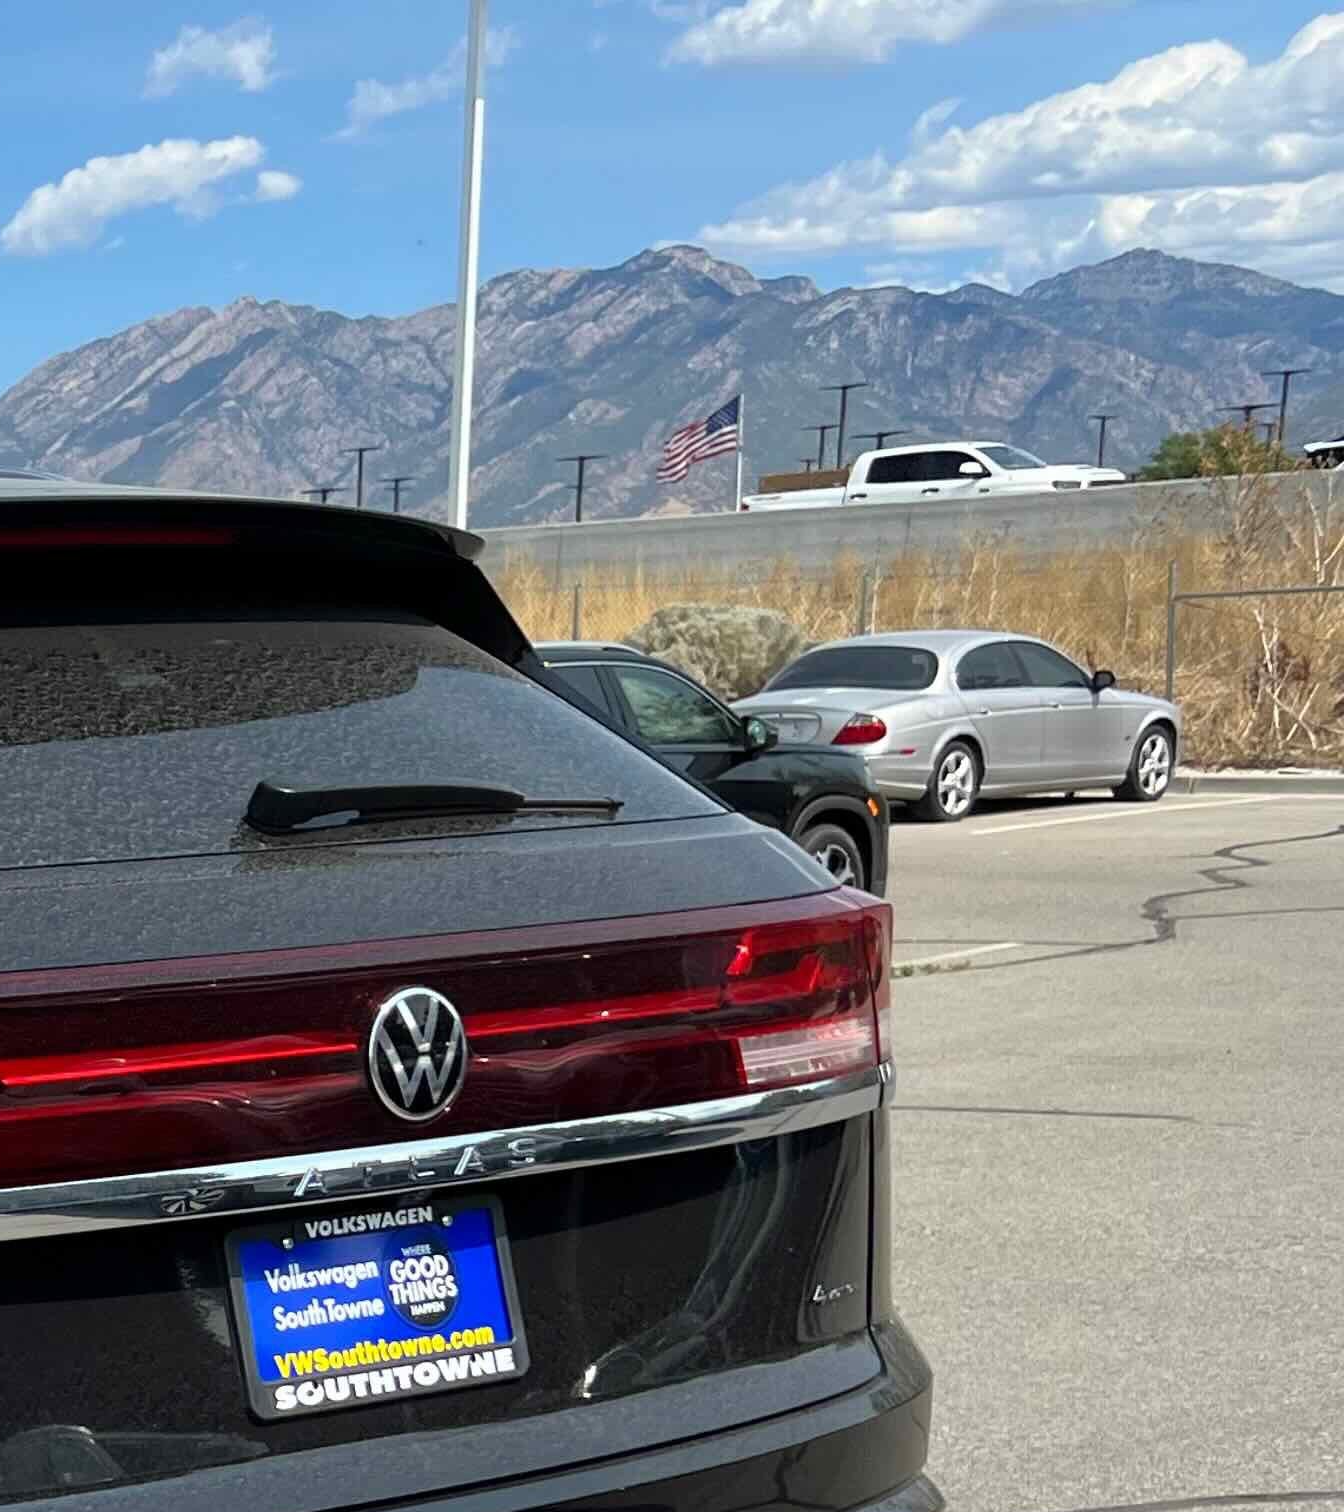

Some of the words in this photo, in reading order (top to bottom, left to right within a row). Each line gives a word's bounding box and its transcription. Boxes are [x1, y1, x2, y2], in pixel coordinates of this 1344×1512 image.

[293, 1138, 536, 1197] ATLAS
[304, 1206, 434, 1239] VOLKSWAGEN
[401, 1244, 431, 1256] WHERE
[264, 1260, 379, 1293] Volkswagen
[390, 1254, 449, 1283] GOOD
[389, 1275, 458, 1304] THINGS
[273, 1297, 385, 1331] SouthTowne
[410, 1301, 446, 1316] HAPPEN
[273, 1325, 495, 1379] VWSouthtowne.com
[274, 1347, 516, 1411] SOUTHTOWNE
